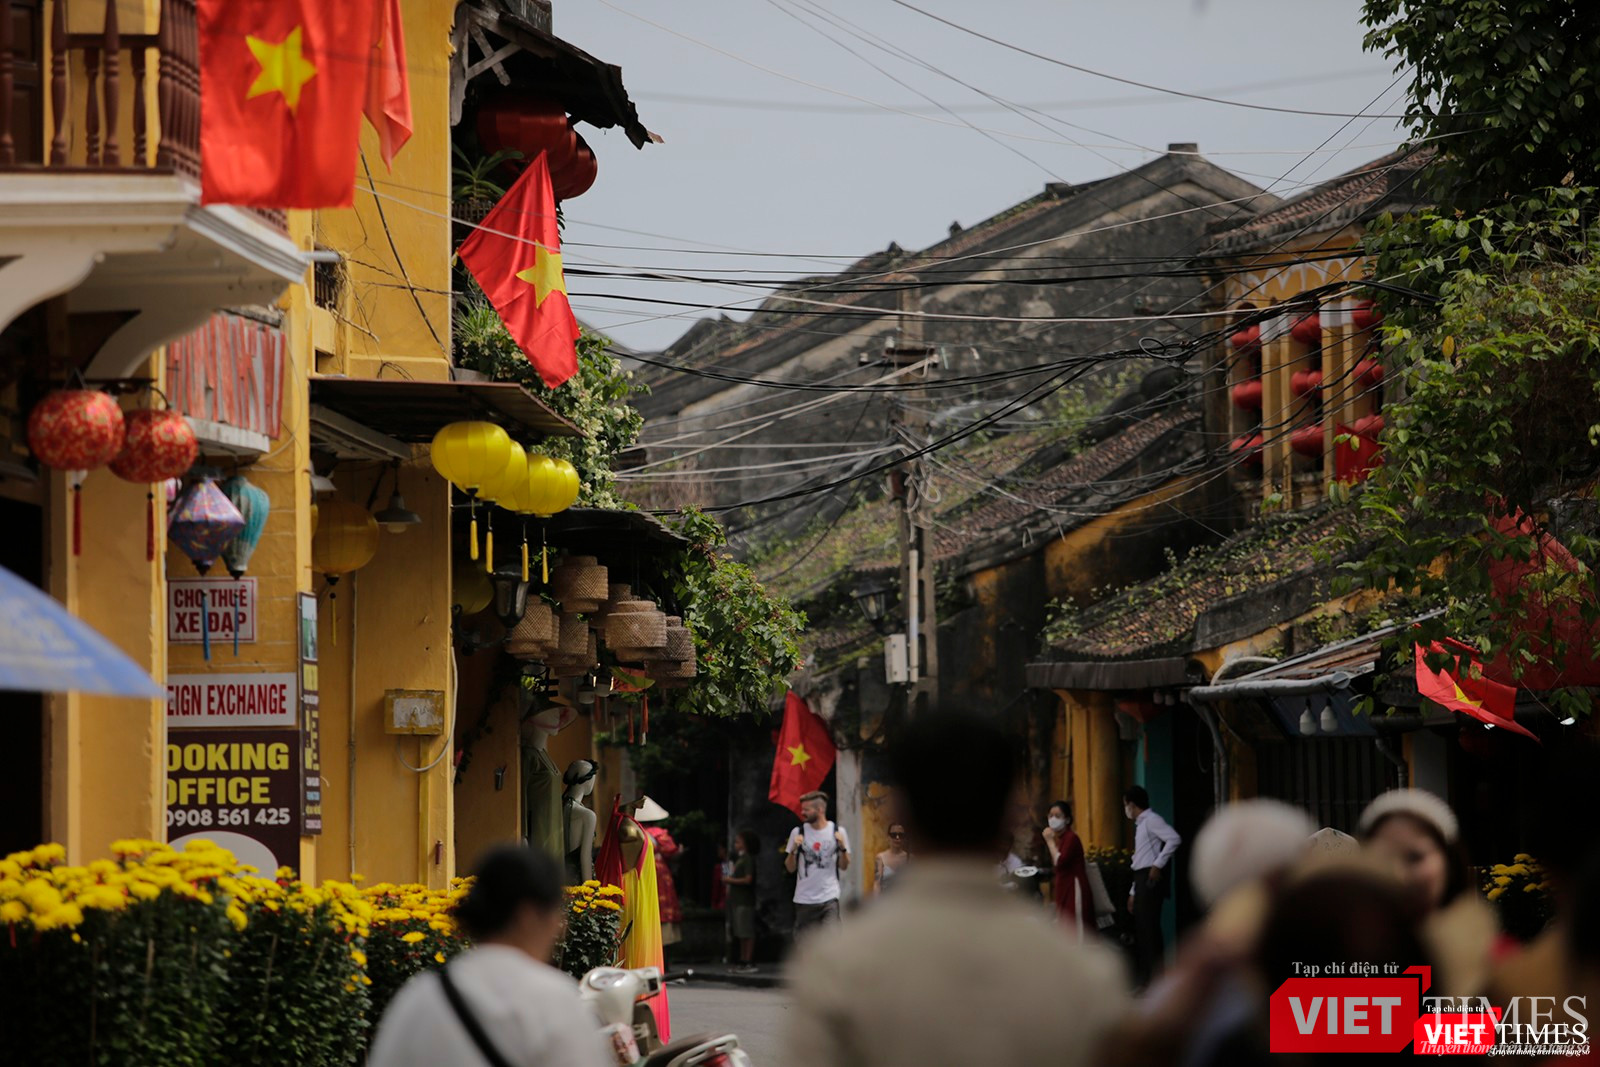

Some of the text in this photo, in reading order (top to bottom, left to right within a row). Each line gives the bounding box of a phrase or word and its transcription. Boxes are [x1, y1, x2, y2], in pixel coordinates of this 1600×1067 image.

[174, 584, 248, 608] CHO THUÊ
[175, 612, 247, 638] XE ĐẠP
[207, 684, 287, 716] EXCHANGE
[167, 743, 289, 771] OOKING
[167, 777, 271, 805] OFFICE
[167, 809, 213, 827] 0908
[217, 808, 250, 826] 561
[254, 807, 291, 825] 425
